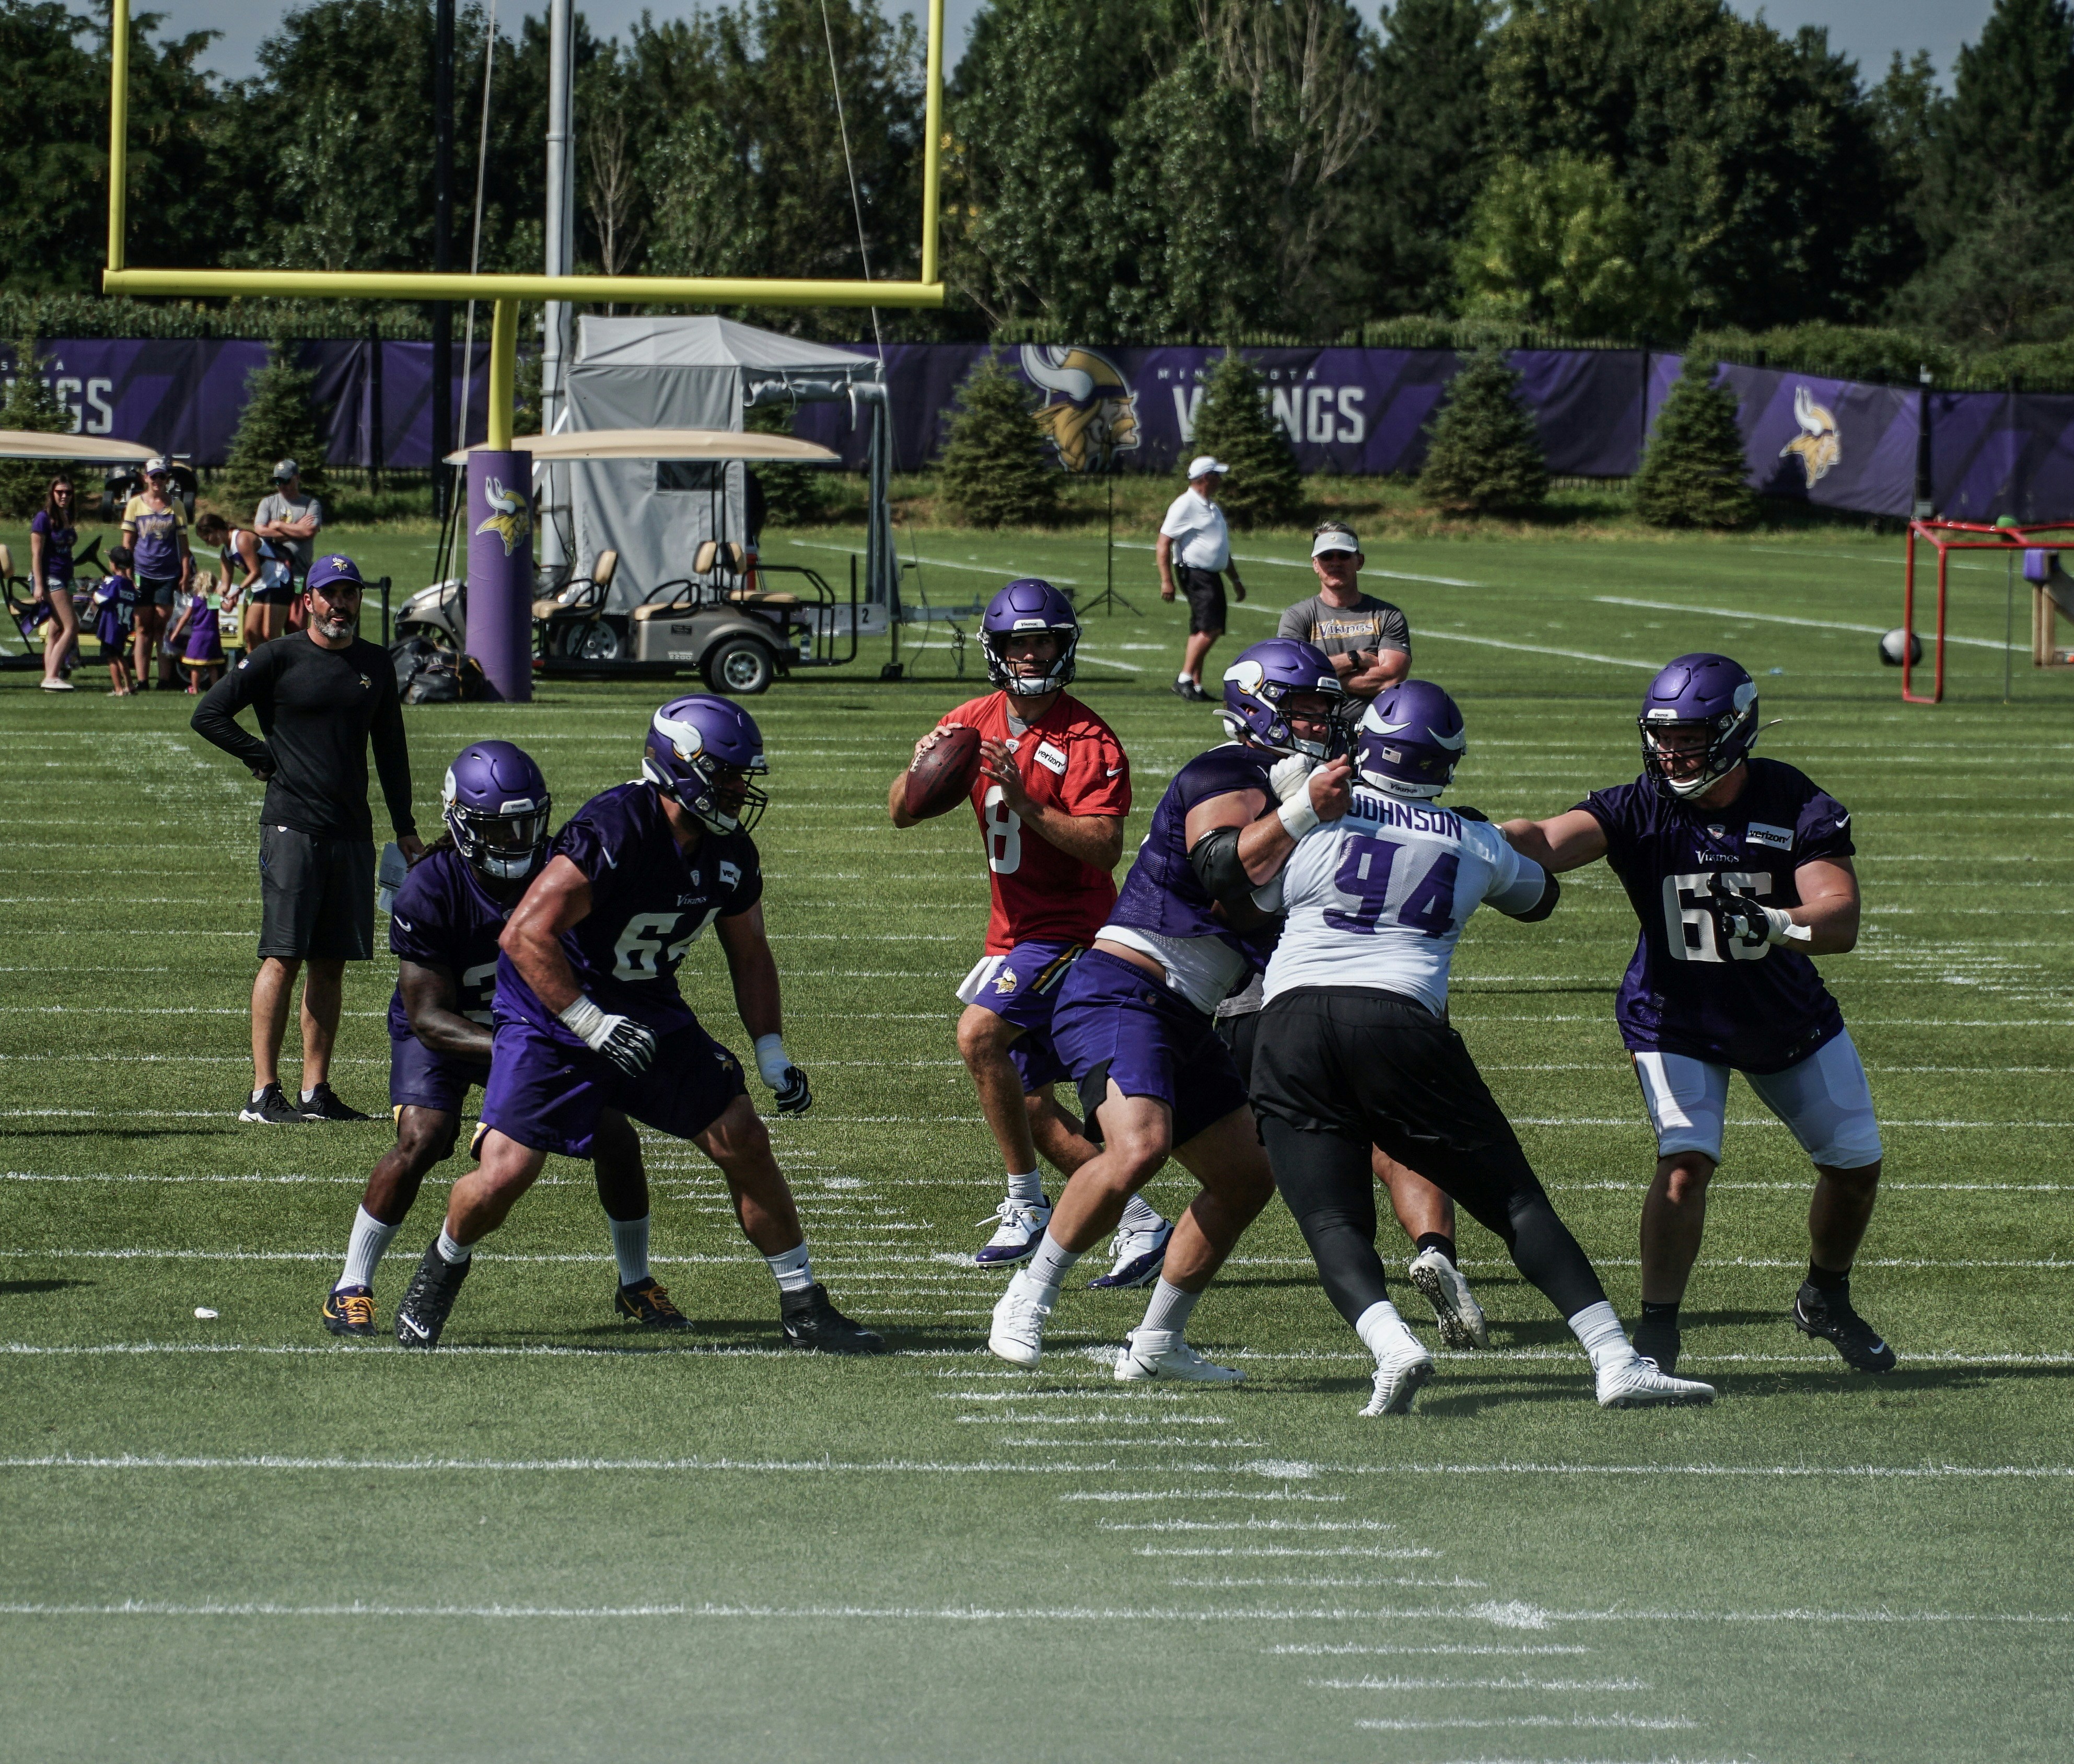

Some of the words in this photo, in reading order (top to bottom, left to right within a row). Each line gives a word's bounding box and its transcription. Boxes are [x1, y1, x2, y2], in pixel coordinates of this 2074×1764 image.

[1, 359, 64, 370] SA
[1158, 368, 1316, 380] MINOTA
[4, 377, 112, 434] GS
[1172, 385, 1366, 443] VNGS
[862, 608, 869, 624] 2
[1038, 749, 1062, 768] verizon
[985, 785, 1021, 875] 8
[1346, 794, 1462, 842] JOHNSON
[1750, 830, 1787, 844] verizon
[1322, 835, 1460, 939] 94
[1662, 872, 1772, 963] 65
